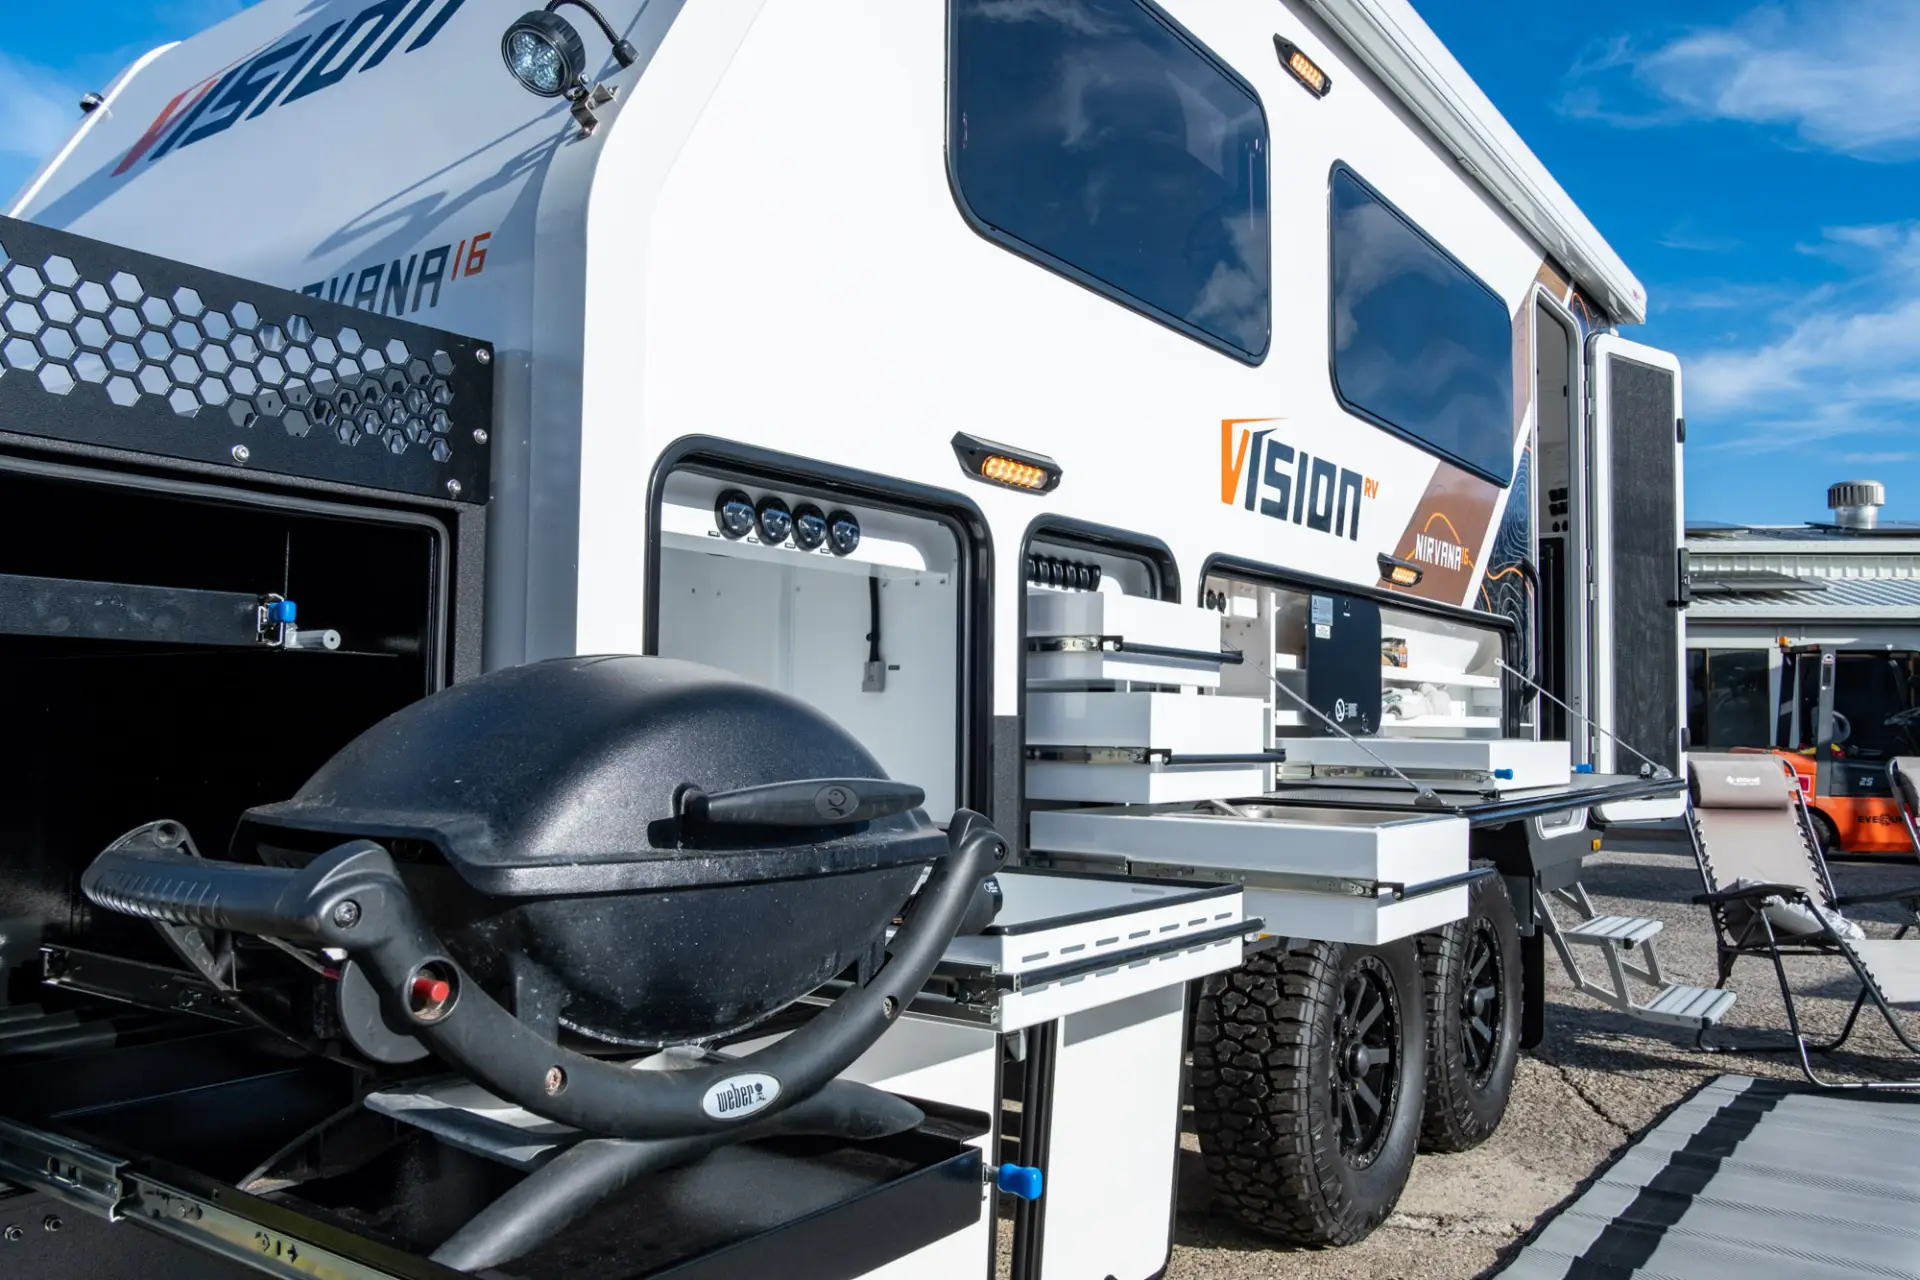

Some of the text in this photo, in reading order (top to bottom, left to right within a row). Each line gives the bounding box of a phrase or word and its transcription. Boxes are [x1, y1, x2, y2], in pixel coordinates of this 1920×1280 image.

[1221, 417, 1379, 542] VISION RV
[1415, 533, 1462, 572] NIRVANA
[716, 1083, 754, 1112] weber
